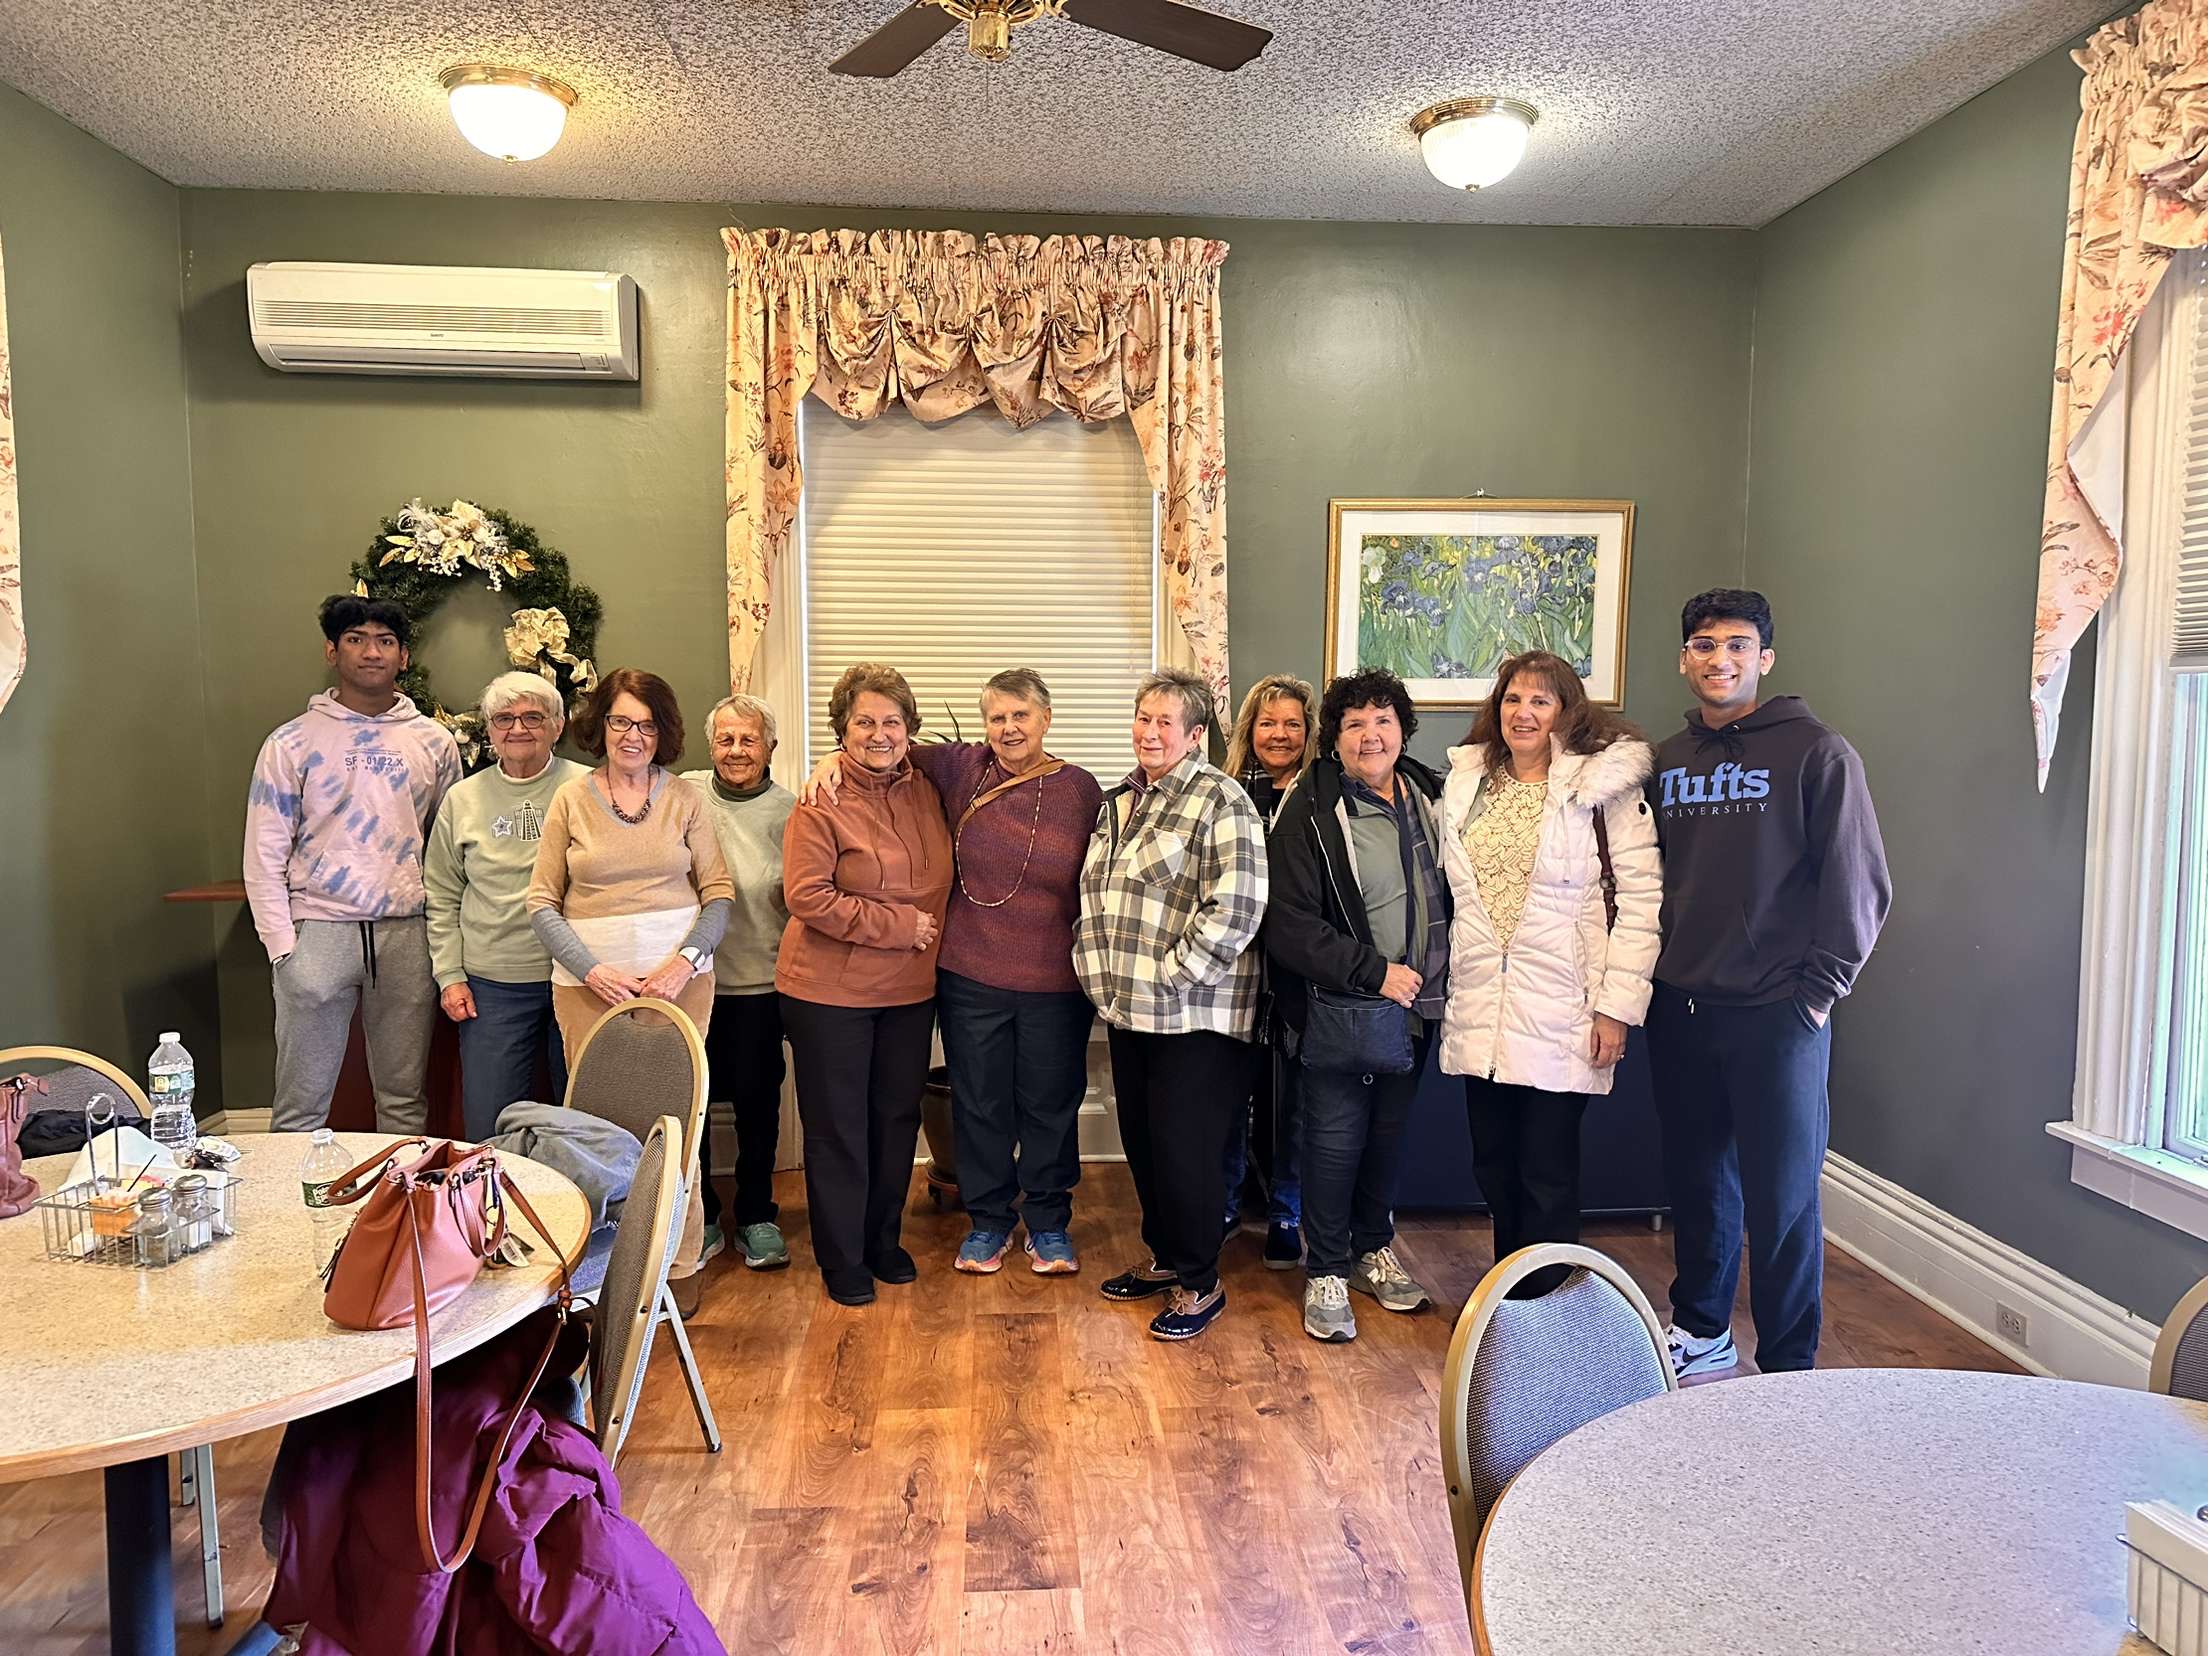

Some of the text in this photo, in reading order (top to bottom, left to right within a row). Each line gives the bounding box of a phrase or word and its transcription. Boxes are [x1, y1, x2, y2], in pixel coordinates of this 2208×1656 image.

[345, 756, 358, 766] SF
[1659, 762, 1770, 807] Tufts
[1665, 802, 1768, 818] NIVERSITY
